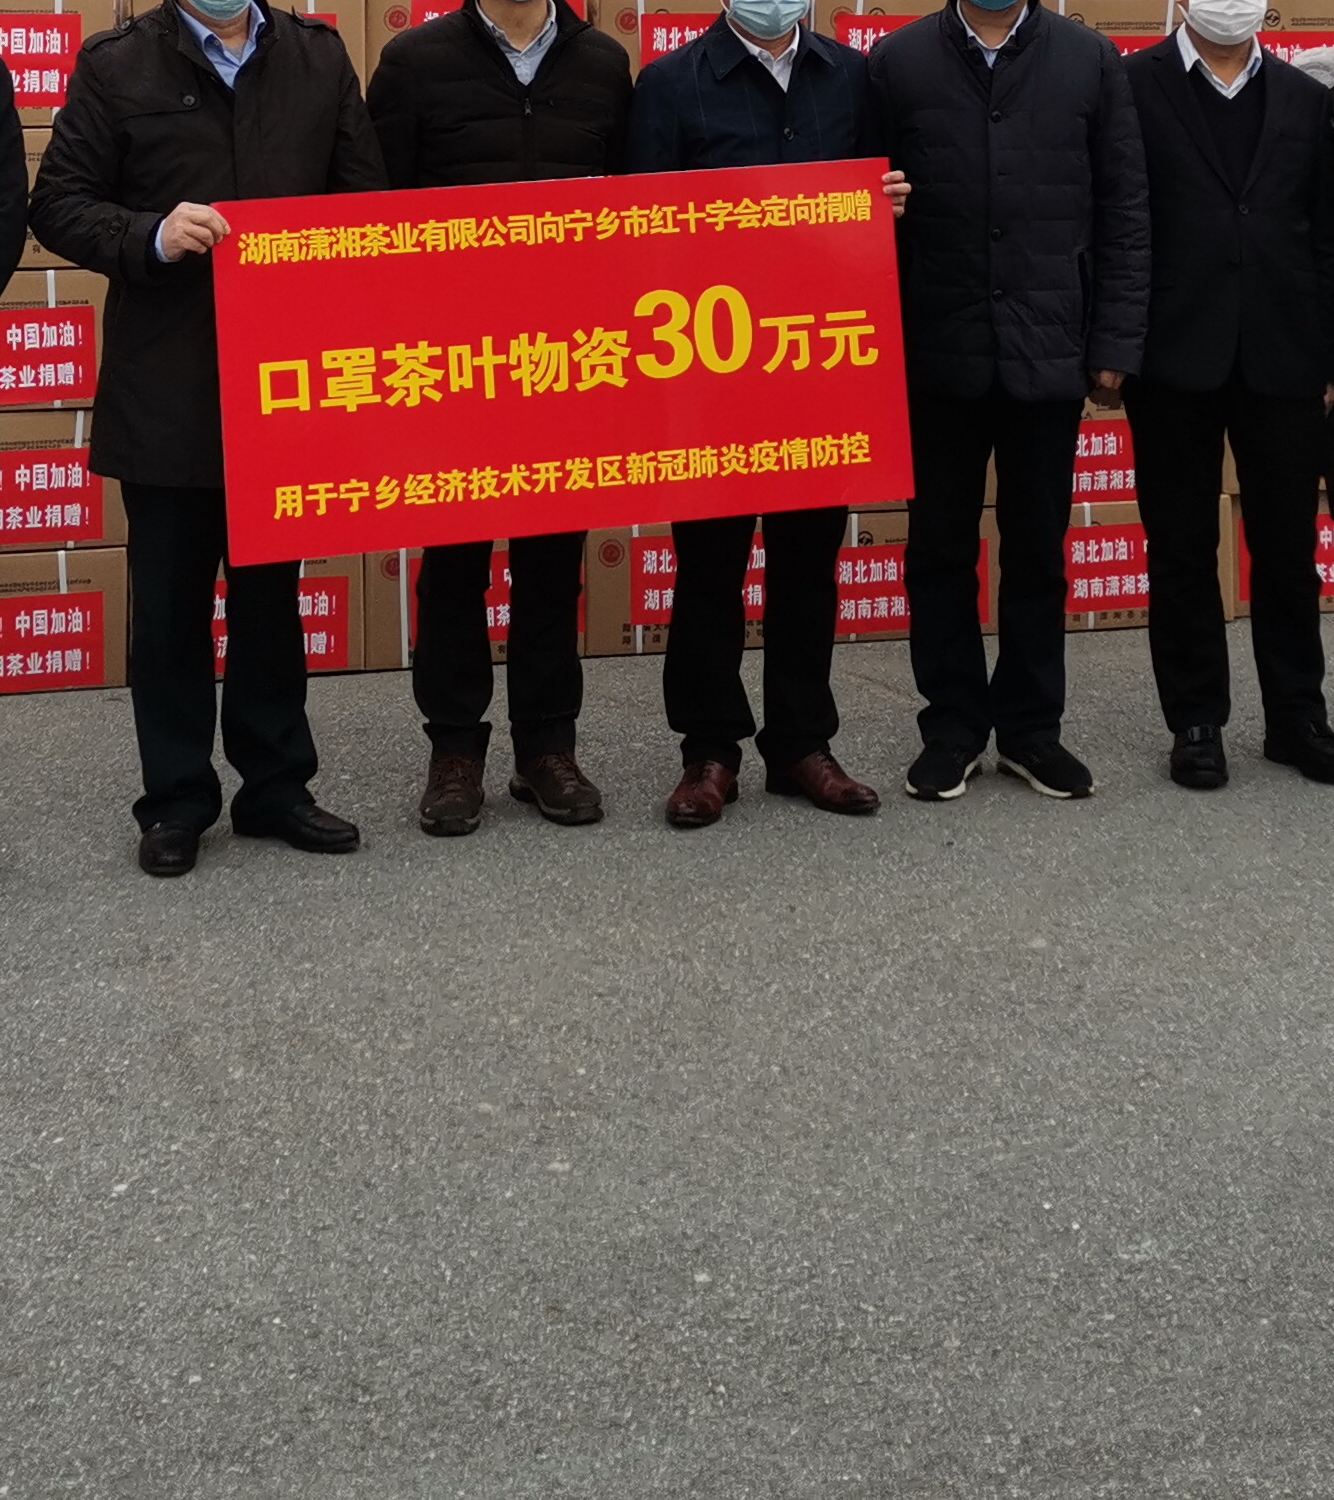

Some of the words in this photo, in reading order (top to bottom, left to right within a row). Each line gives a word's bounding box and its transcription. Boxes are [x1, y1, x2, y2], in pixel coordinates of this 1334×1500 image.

[238, 190, 873, 265] 湖南潇湘茶业有限公司向宁乡市红十字会定向捐赠
[258, 285, 880, 415] 口罩茶叶物资30万元
[273, 432, 872, 520] 用于宁乡经济技术开发区新冠肺炎疫情防控
[1072, 468, 1135, 493] 南潇湘茶
